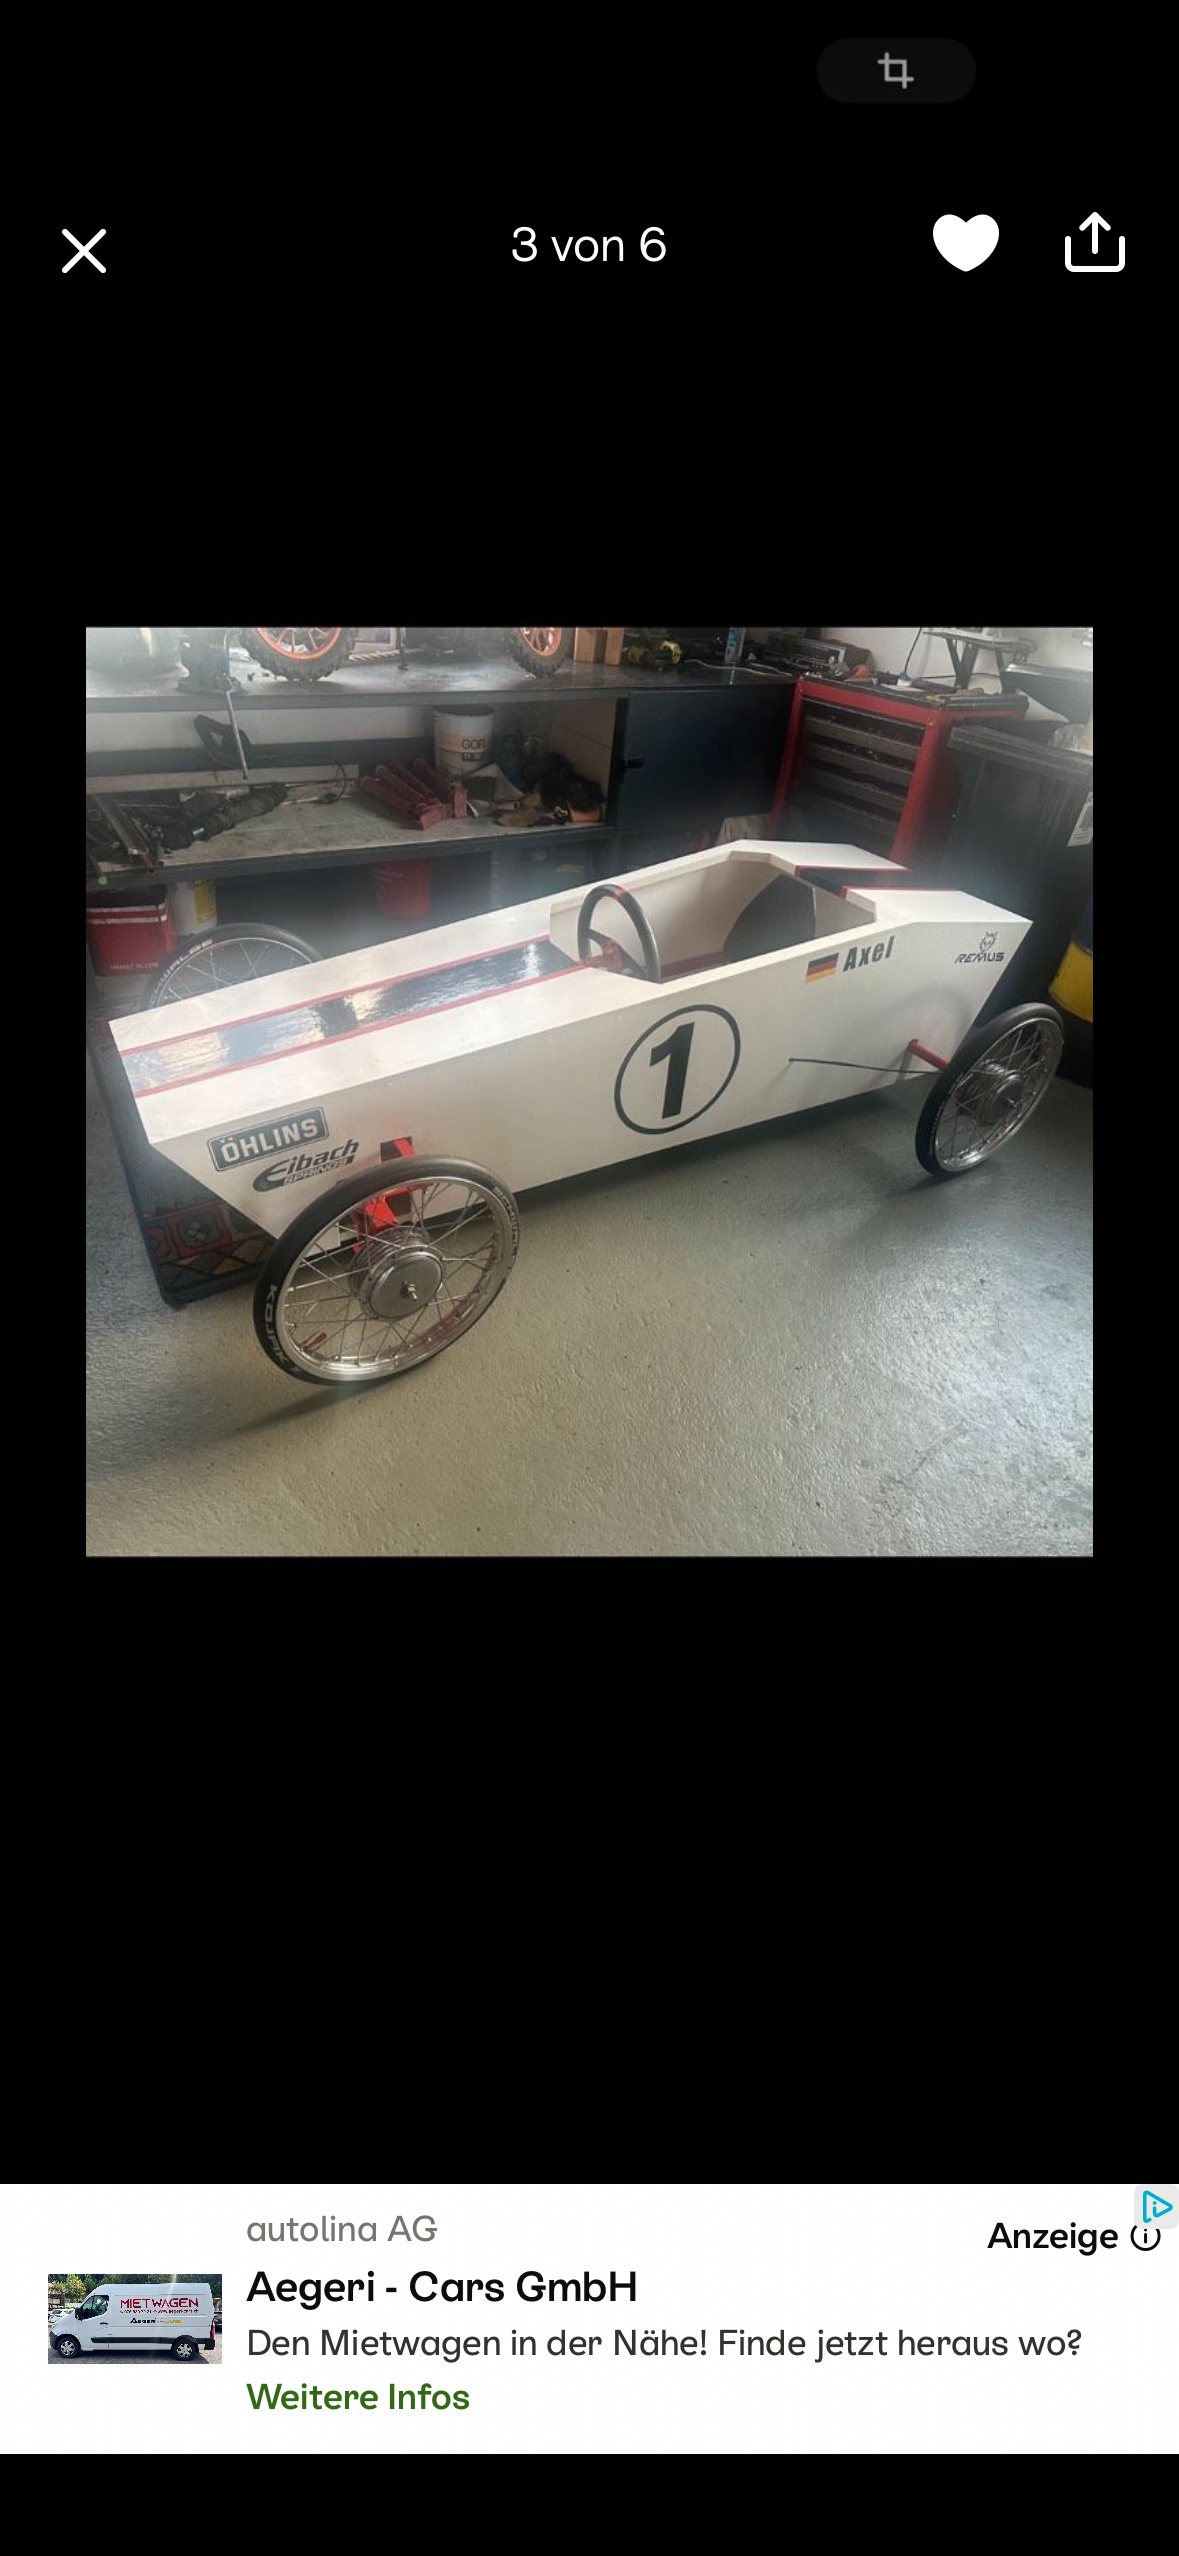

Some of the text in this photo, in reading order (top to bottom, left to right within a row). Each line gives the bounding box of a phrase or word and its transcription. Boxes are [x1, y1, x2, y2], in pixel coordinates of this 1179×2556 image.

[512, 227, 666, 262] 3 von 6
[842, 936, 895, 972] Axel
[954, 952, 1005, 964] REMUS
[649, 1021, 695, 1119] 1
[220, 1117, 318, 1163] ÖHLINS
[252, 1139, 360, 1192] Eibach
[247, 2215, 437, 2242] autolina AG
[987, 2222, 1118, 2256] Anzeige
[120, 2298, 199, 2309] MIETWAGEN
[246, 2271, 374, 2310] Aegeri
[410, 2271, 504, 2302] Cars
[517, 2271, 636, 2302] GmbH
[249, 2329, 1081, 2363] Den Mietwagen in der Nähe! Finde jetzt heraus wo?
[246, 2383, 469, 2410] Weitere Infos
